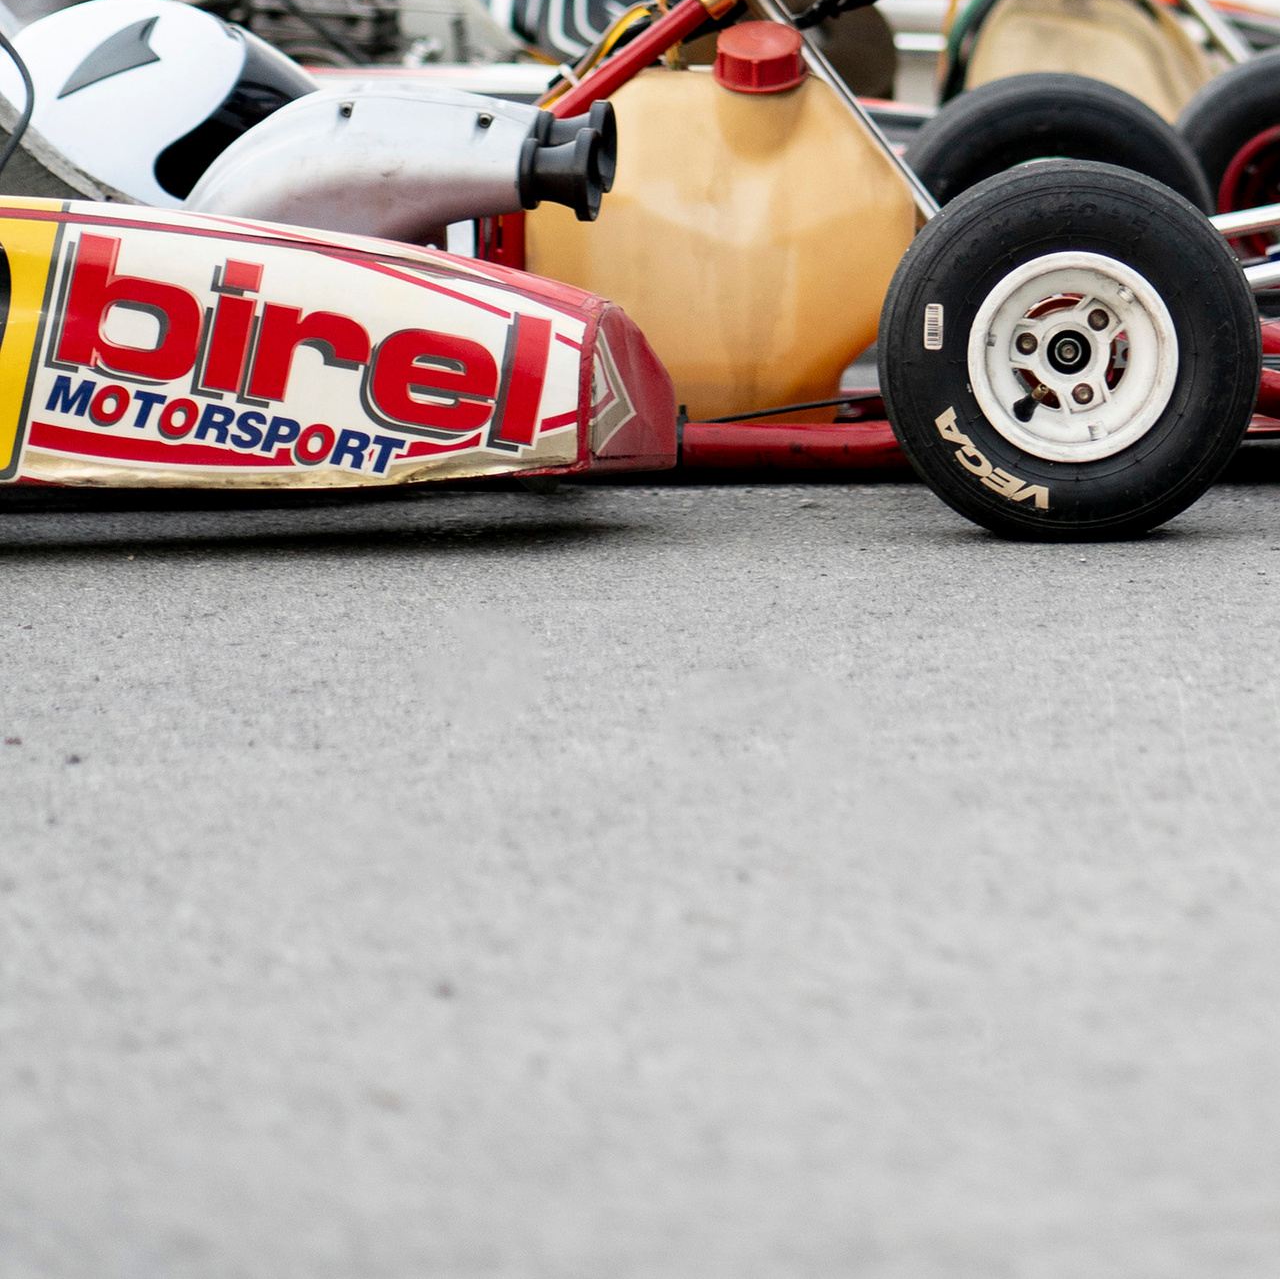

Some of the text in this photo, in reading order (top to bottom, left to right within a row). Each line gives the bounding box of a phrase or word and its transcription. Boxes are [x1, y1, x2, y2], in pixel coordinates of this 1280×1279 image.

[45, 231, 552, 450] birel
[44, 375, 409, 475] MOTORSPORT
[934, 405, 1050, 510] VEGA
